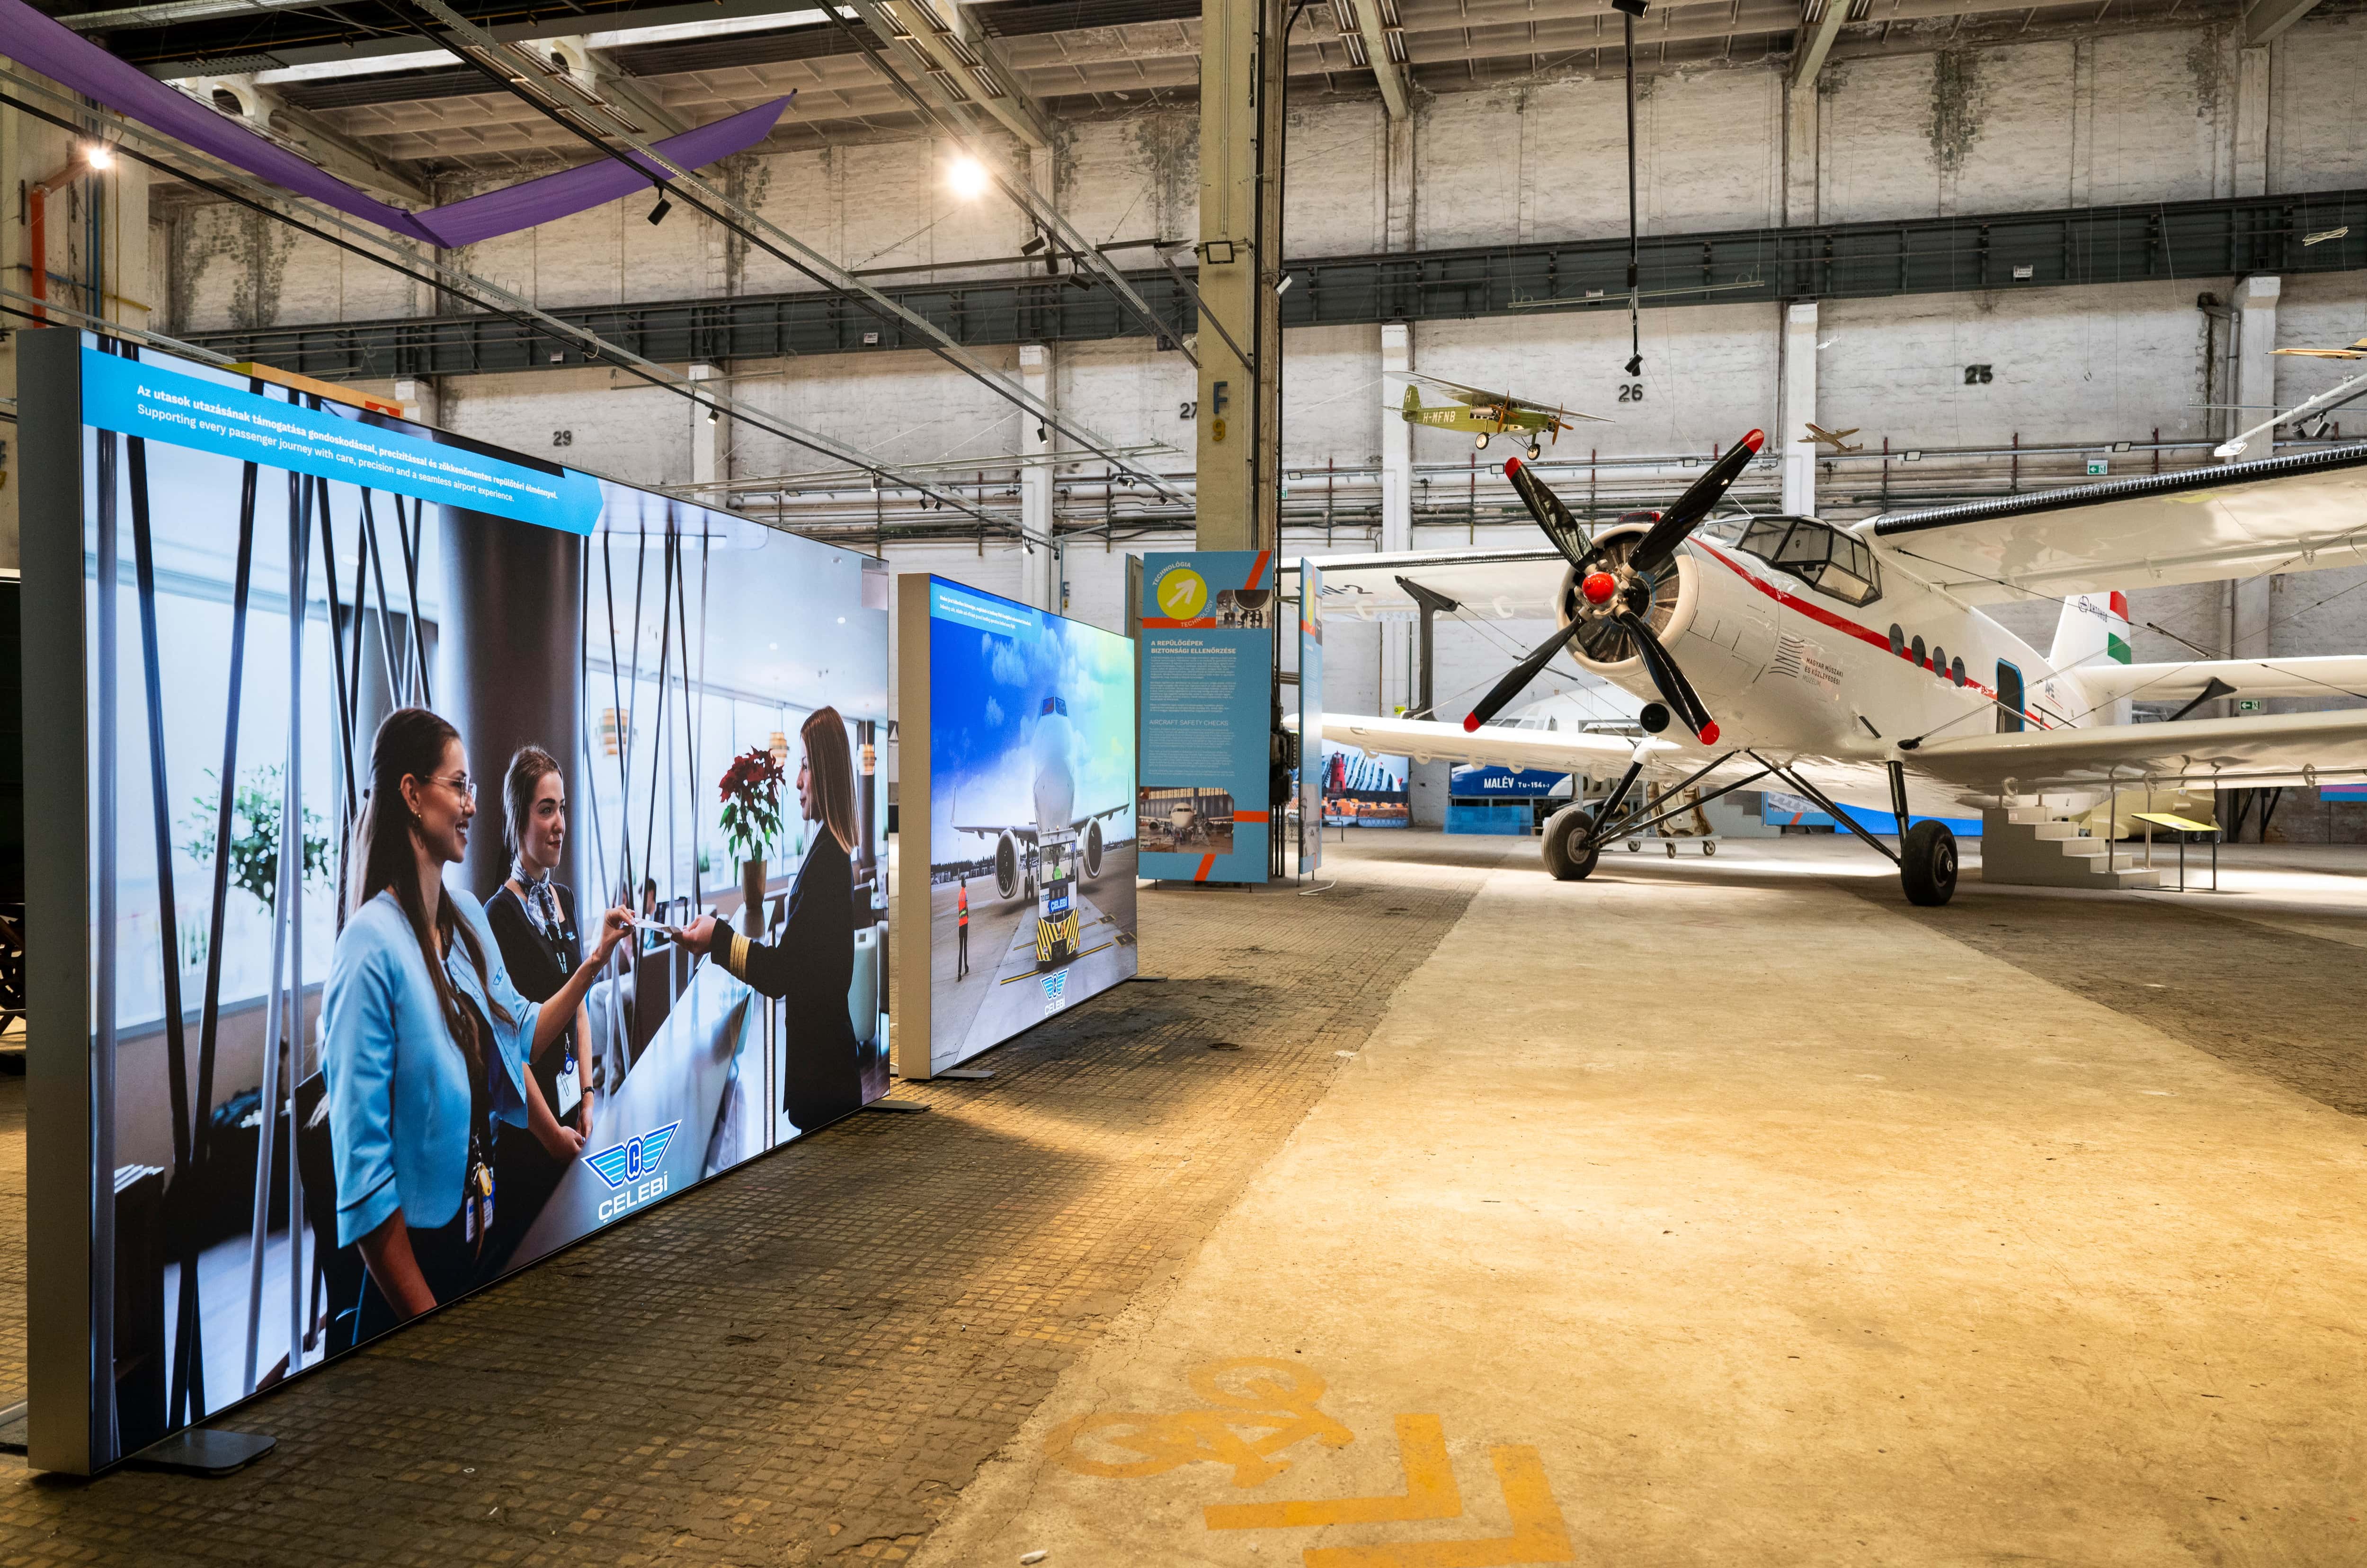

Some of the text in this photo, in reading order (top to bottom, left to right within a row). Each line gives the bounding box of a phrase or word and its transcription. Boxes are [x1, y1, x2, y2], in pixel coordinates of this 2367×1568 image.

[1213, 381, 1228, 414] F
[1405, 391, 1412, 402] H
[1619, 383, 1643, 401] 26
[1180, 402, 1197, 419] 27
[1423, 410, 1456, 423] H-MFNB
[137, 384, 151, 398] Az
[154, 390, 190, 407] utasok
[193, 400, 250, 422] utazásának
[252, 413, 307, 437] támogatása
[308, 428, 377, 455] gondoskodással,
[379, 446, 427, 466] precizitással
[429, 458, 437, 468] és
[1212, 419, 1226, 441] 9
[552, 430, 572, 446] 29
[137, 403, 196, 429] Supporting
[199, 420, 226, 437] every
[229, 427, 277, 446] passenger
[278, 438, 312, 456] journey
[314, 445, 333, 459] with
[336, 452, 356, 466] care,
[358, 458, 394, 475] precision
[396, 464, 410, 477] and
[418, 471, 452, 486] seamless
[453, 479, 476, 493] airport
[478, 485, 515, 502] experience.
[1152, 561, 1191, 587] TECHNOLÓGIA
[1180, 599, 1213, 628] TECHNOLOGY
[1804, 665, 1811, 673] ÉS
[1806, 657, 1824, 669] MAGYAR
[1484, 775, 1514, 788] MALÉV
[598, 1170, 668, 1224] ÇELEBİ
